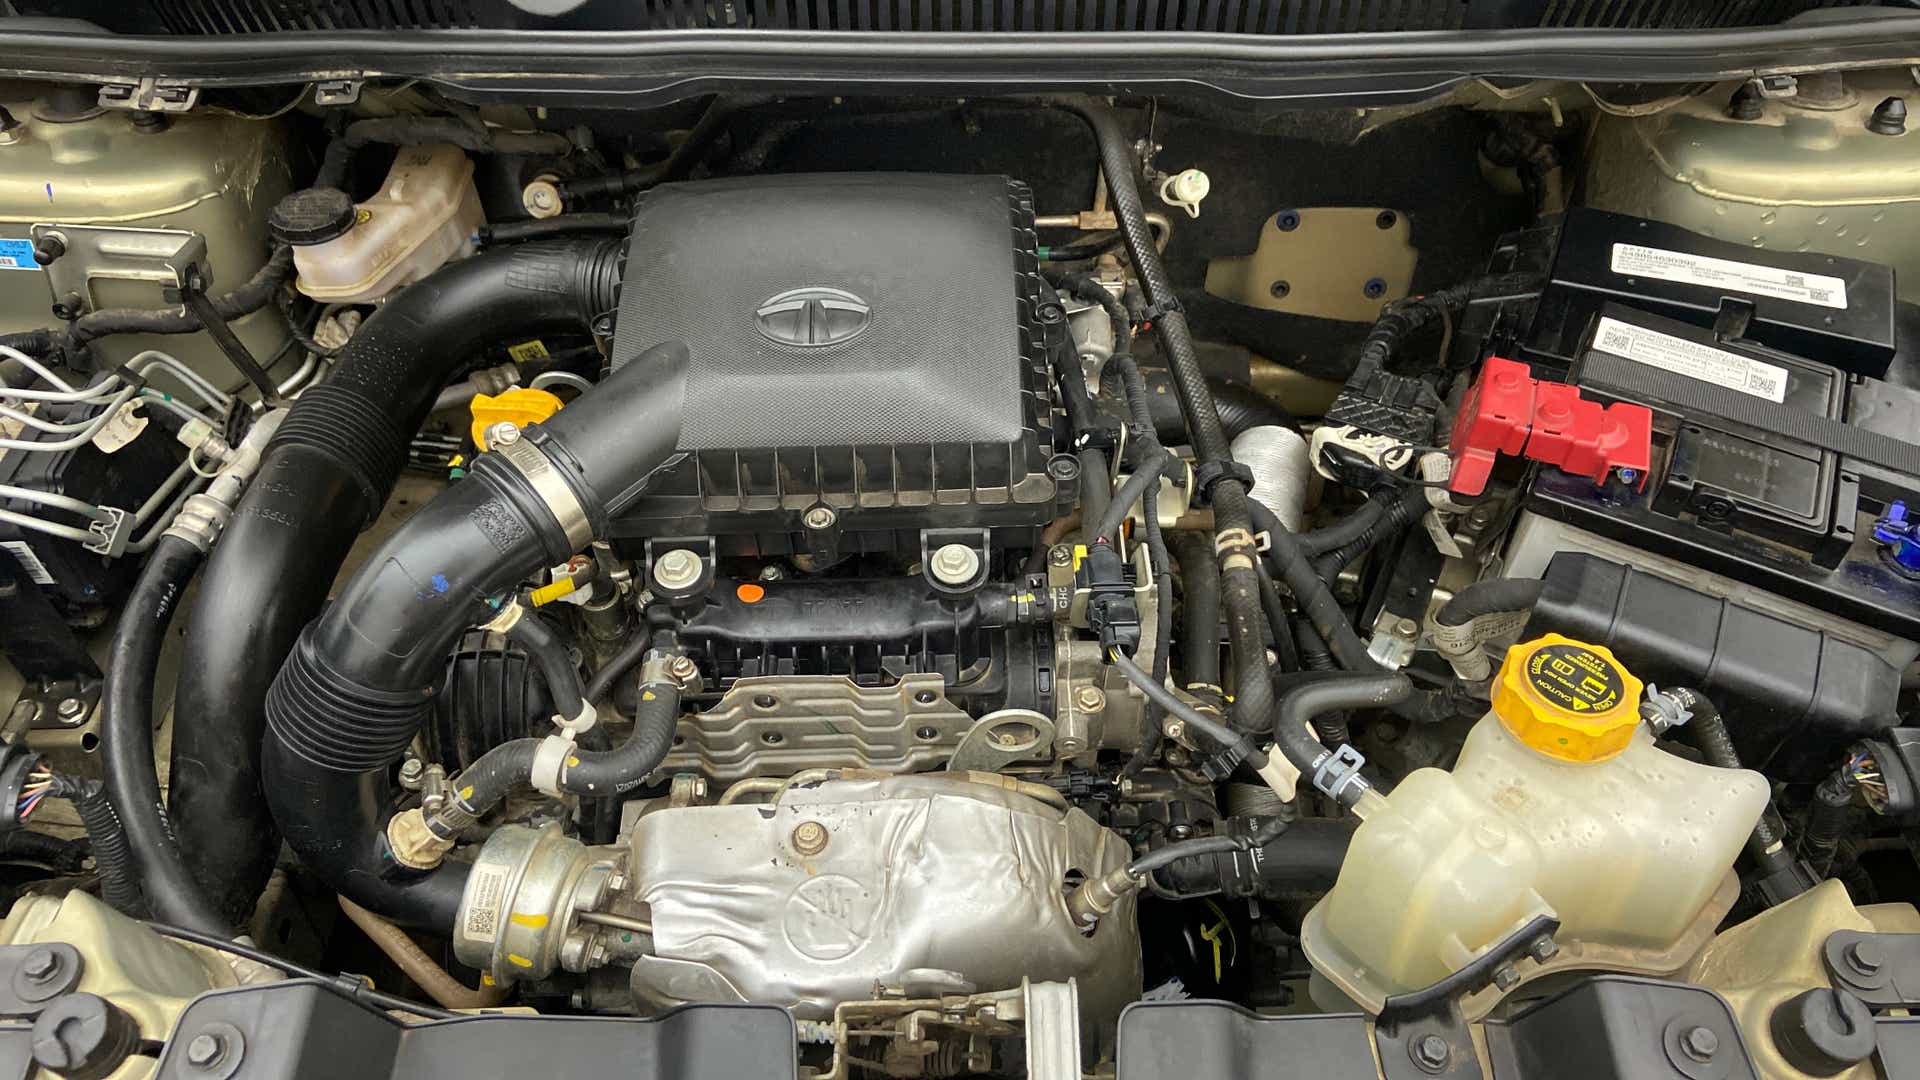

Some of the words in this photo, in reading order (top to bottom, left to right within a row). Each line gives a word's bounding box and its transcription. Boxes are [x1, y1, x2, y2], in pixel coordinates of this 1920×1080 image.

[1543, 669, 1558, 679] HOT
[1557, 676, 1575, 689] OPEN
[1536, 679, 1572, 702] CAUTION
[1574, 687, 1597, 702] NEVER
